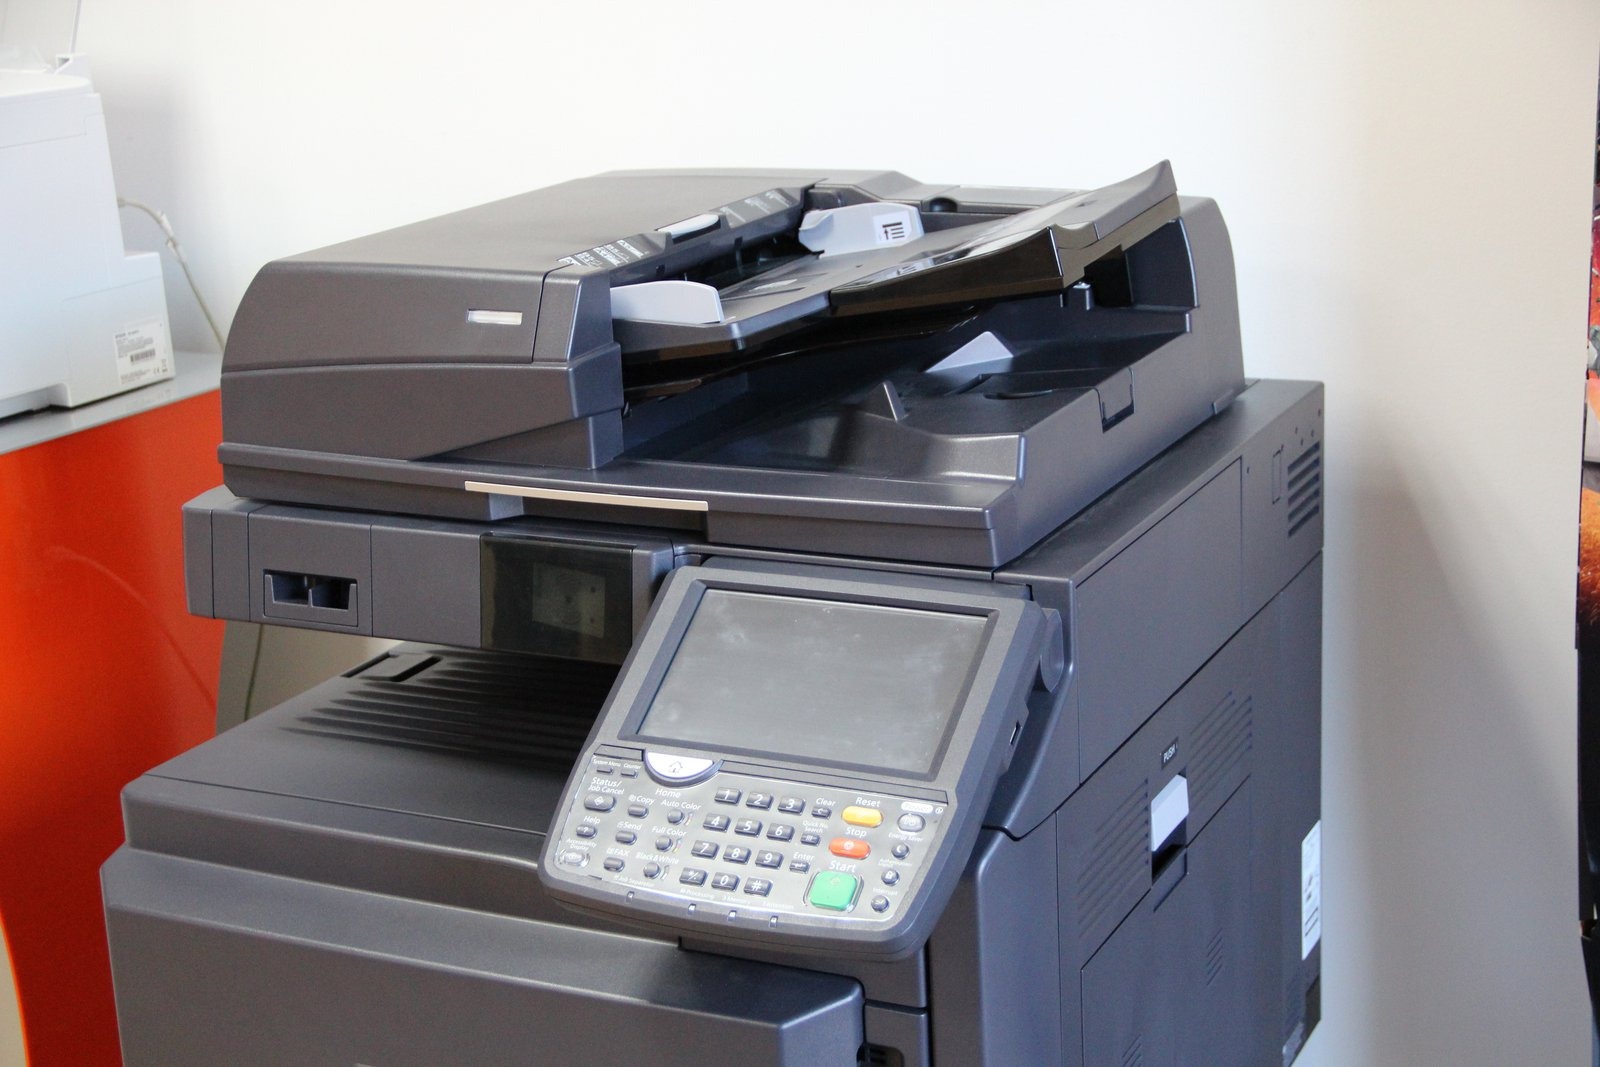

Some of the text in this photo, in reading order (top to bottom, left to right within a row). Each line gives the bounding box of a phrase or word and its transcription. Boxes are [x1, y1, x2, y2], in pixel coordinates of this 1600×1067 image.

[1163, 743, 1176, 763] PUSH
[592, 776, 622, 787] Status/
[588, 784, 625, 795] Job Cancel
[655, 788, 681, 799] Home
[724, 789, 732, 800] 1
[637, 795, 656, 805] Copy
[661, 799, 702, 810] Auto Color
[753, 794, 763, 805] 2
[786, 798, 795, 809] 3
[815, 797, 836, 807] Clear
[855, 797, 881, 808] Reset
[583, 815, 601, 825] Help
[711, 816, 720, 827] 4
[743, 820, 753, 831] 5
[622, 821, 642, 831] Send
[652, 826, 687, 837] Full Color
[775, 825, 783, 836] 6
[845, 827, 867, 838] Stop
[701, 842, 710, 853] 7
[731, 847, 741, 858] 8
[614, 849, 630, 858] FAX
[764, 852, 773, 863] 9
[793, 852, 815, 861] Enter
[828, 860, 857, 873] Start
[720, 875, 728, 886] 0
